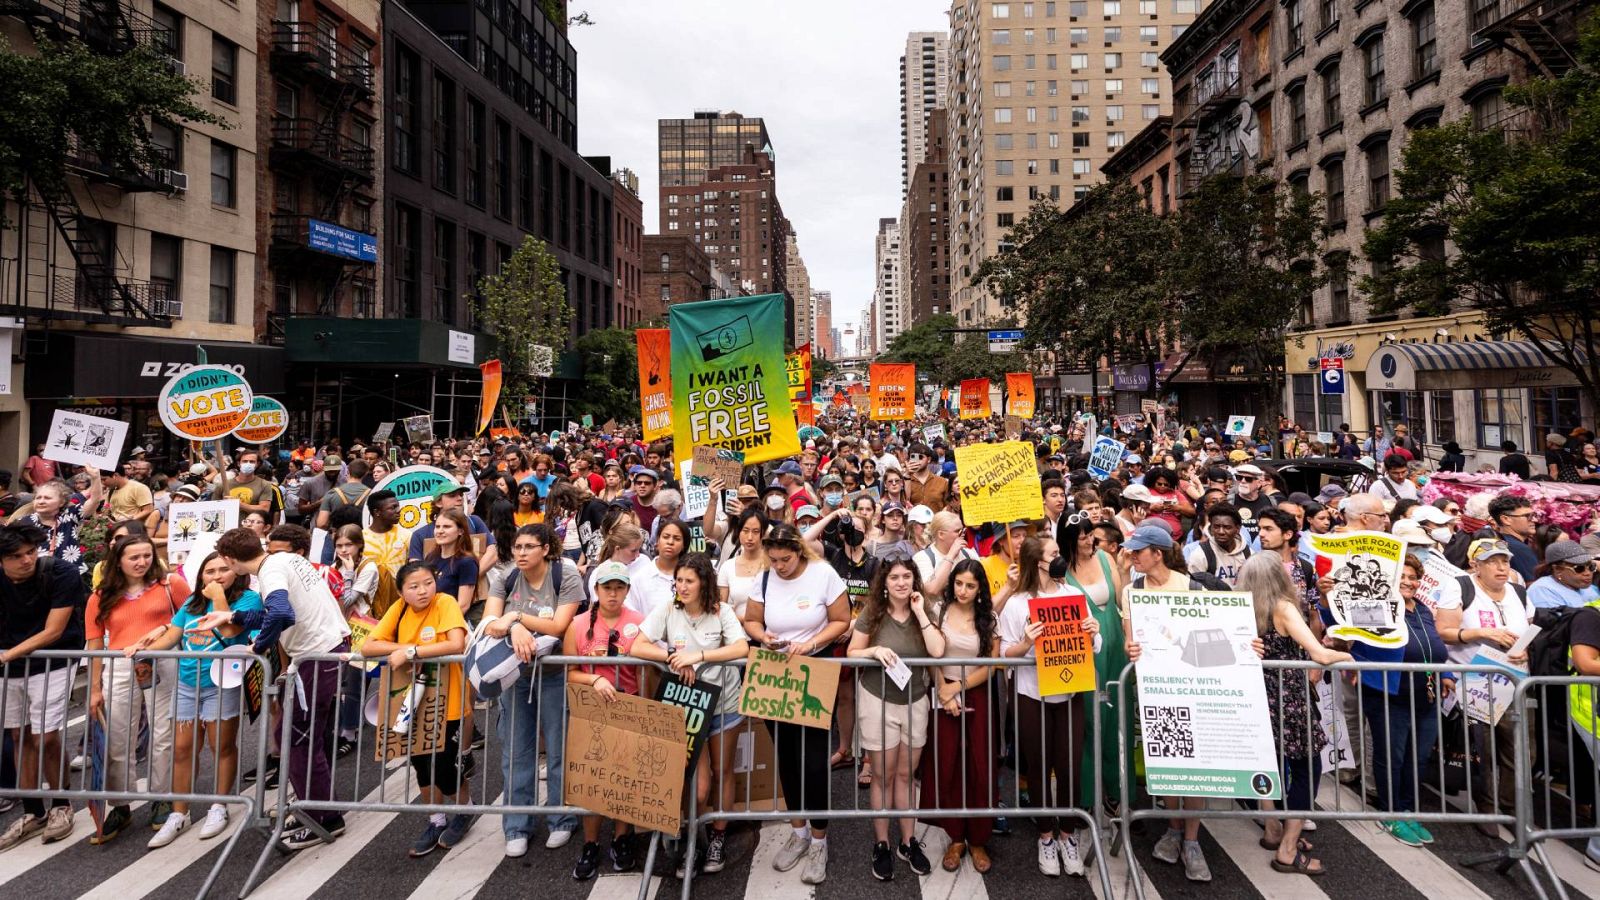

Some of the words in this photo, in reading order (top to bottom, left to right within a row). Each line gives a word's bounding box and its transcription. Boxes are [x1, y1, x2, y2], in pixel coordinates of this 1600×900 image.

[187, 374, 229, 389] DIDN'T
[689, 372, 695, 389] I
[698, 365, 749, 387] WANT
[753, 363, 765, 380] A
[171, 388, 245, 419] VOTE
[688, 380, 766, 412] FOSSIL
[878, 407, 906, 417] FIRE
[187, 419, 209, 429] FOR
[689, 401, 771, 444] FREE
[962, 446, 1032, 500] REGENERATIVA
[965, 450, 1011, 481] CULTURA
[988, 458, 1034, 497] ABUNDANTE
[396, 479, 443, 497] DIDN'T
[687, 538, 707, 553] ND
[1349, 538, 1369, 546] THE
[1370, 538, 1399, 551] ROAD
[1376, 549, 1397, 558] YORK
[1131, 595, 1172, 605] DON'T
[1174, 596, 1190, 606] BE
[1192, 597, 1202, 606] A
[1203, 597, 1251, 607] FOSSIL
[1036, 605, 1081, 623] BIDEN
[1170, 608, 1210, 618] FOOL!
[1042, 636, 1086, 655] CLIMATE
[756, 649, 787, 663] STOP
[1044, 653, 1086, 667] EMERGENCY
[1142, 675, 1194, 686] RESILIENCY
[1195, 677, 1221, 686] WITH
[662, 681, 712, 710] BIDEN
[1144, 686, 1176, 696] SMALL
[1176, 688, 1207, 697] SCALE
[1207, 688, 1245, 698] BIOGAS
[647, 705, 685, 723] FUELS
[659, 720, 679, 731] THE
[569, 763, 588, 775] BUT
[590, 767, 607, 781] WE
[609, 772, 661, 796] CREATED
[664, 787, 674, 800] A
[567, 782, 584, 797] LOT
[587, 784, 602, 798] OF
[602, 792, 635, 805] VALUE
[642, 796, 666, 809] FOR
[606, 802, 680, 828] SHAREHOLDERS
